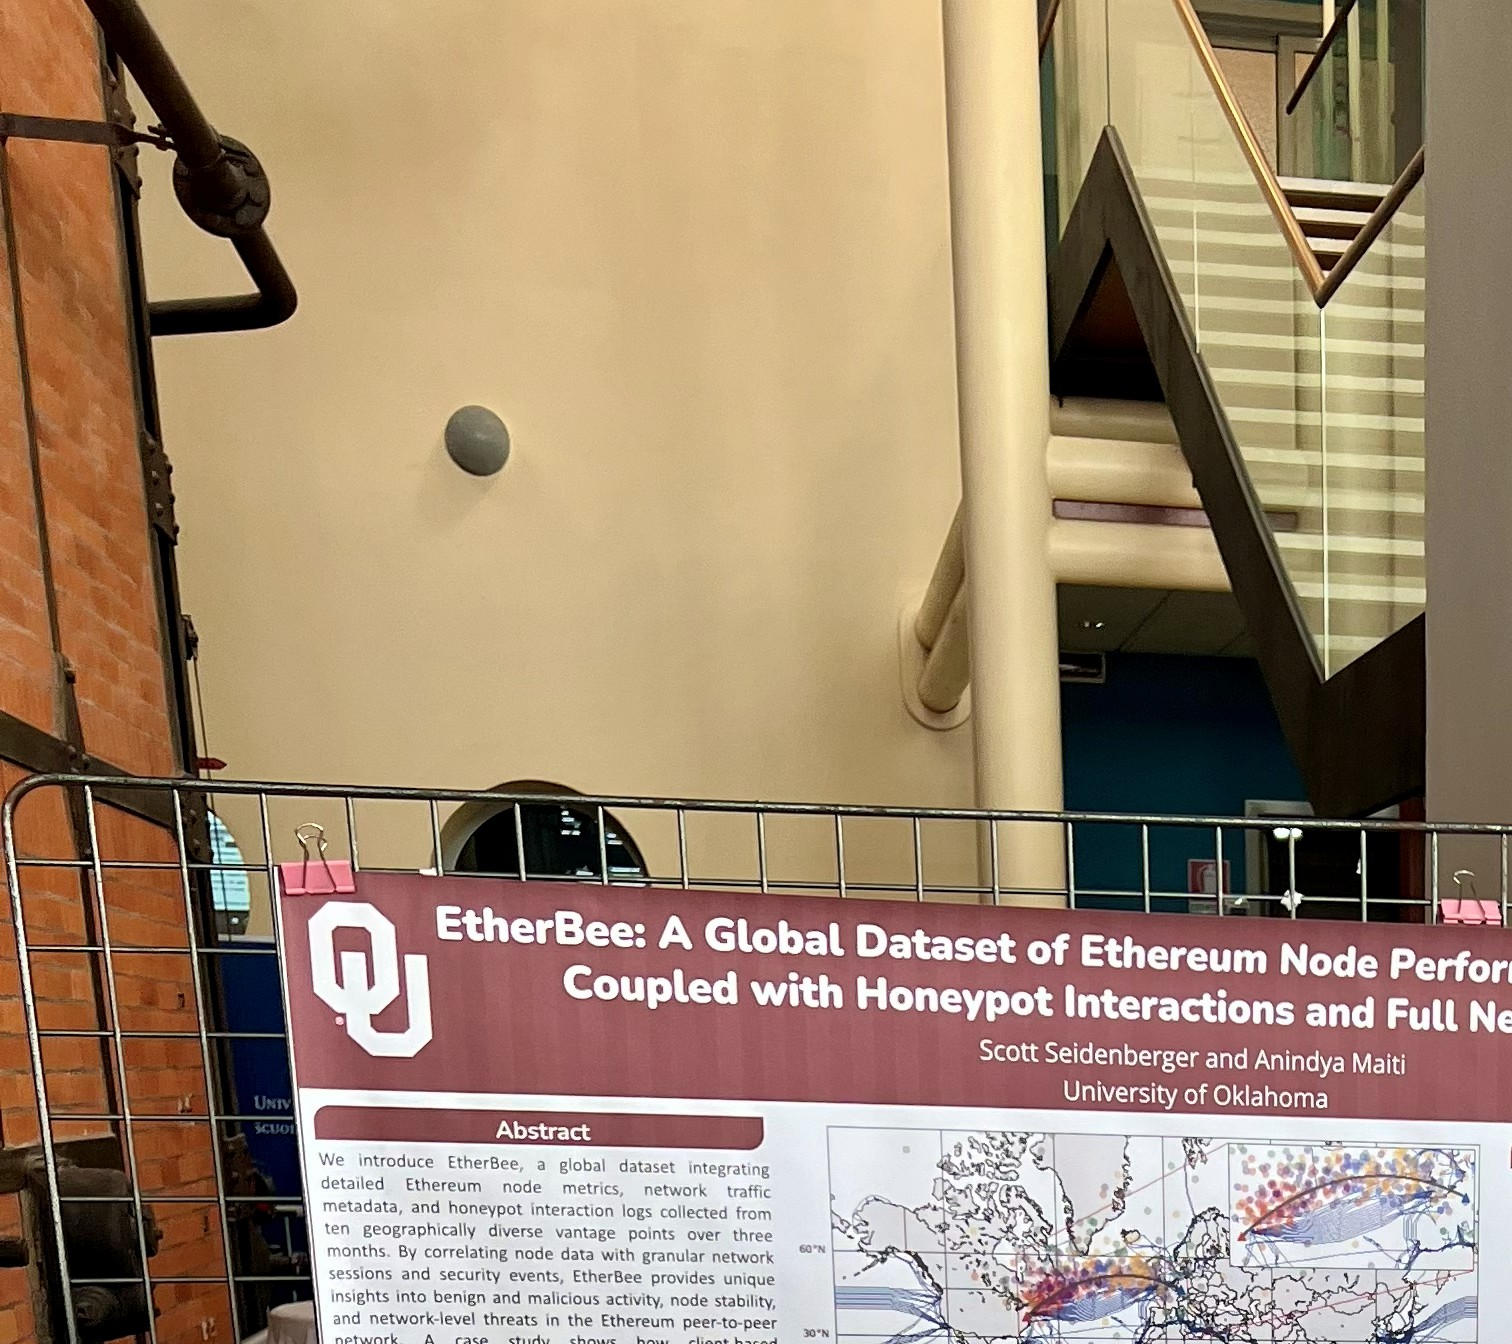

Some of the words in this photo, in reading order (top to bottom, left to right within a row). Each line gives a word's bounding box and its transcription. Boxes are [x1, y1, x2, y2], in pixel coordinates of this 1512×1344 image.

[436, 905, 646, 948] EtherBee:
[658, 914, 693, 950] A
[704, 917, 845, 956] Global
[856, 924, 1016, 963] Dataset
[1026, 933, 1070, 965] of
[1081, 934, 1267, 974] Ethereum
[1280, 942, 1378, 978] Node
[309, 900, 434, 1057] OU
[563, 964, 738, 1009] Coupled
[750, 971, 843, 1008] with
[856, 975, 1054, 1022] Honeypot
[1065, 984, 1294, 1025] Interactions
[1305, 995, 1374, 1029] and
[1387, 997, 1458, 1032] Full
[979, 1039, 1039, 1062] Scott
[1045, 1041, 1200, 1073] Seidenberger
[1205, 1047, 1247, 1070] and
[1254, 1049, 1344, 1078] Anindya
[1352, 1052, 1405, 1075] Maiti
[1063, 1079, 1178, 1110] University
[1184, 1082, 1208, 1105] of
[1213, 1083, 1328, 1109] Oklahoma
[495, 1120, 591, 1141] Abstract
[318, 1152, 344, 1166] We
[359, 1153, 434, 1169] introduce
[448, 1154, 523, 1173] EtherBee,
[537, 1160, 545, 1171] a
[559, 1157, 605, 1174] global
[619, 1158, 675, 1174] dataset
[688, 1162, 770, 1179] integrating
[800, 1244, 826, 1254] 60°N
[803, 1330, 829, 1338] 30°N
